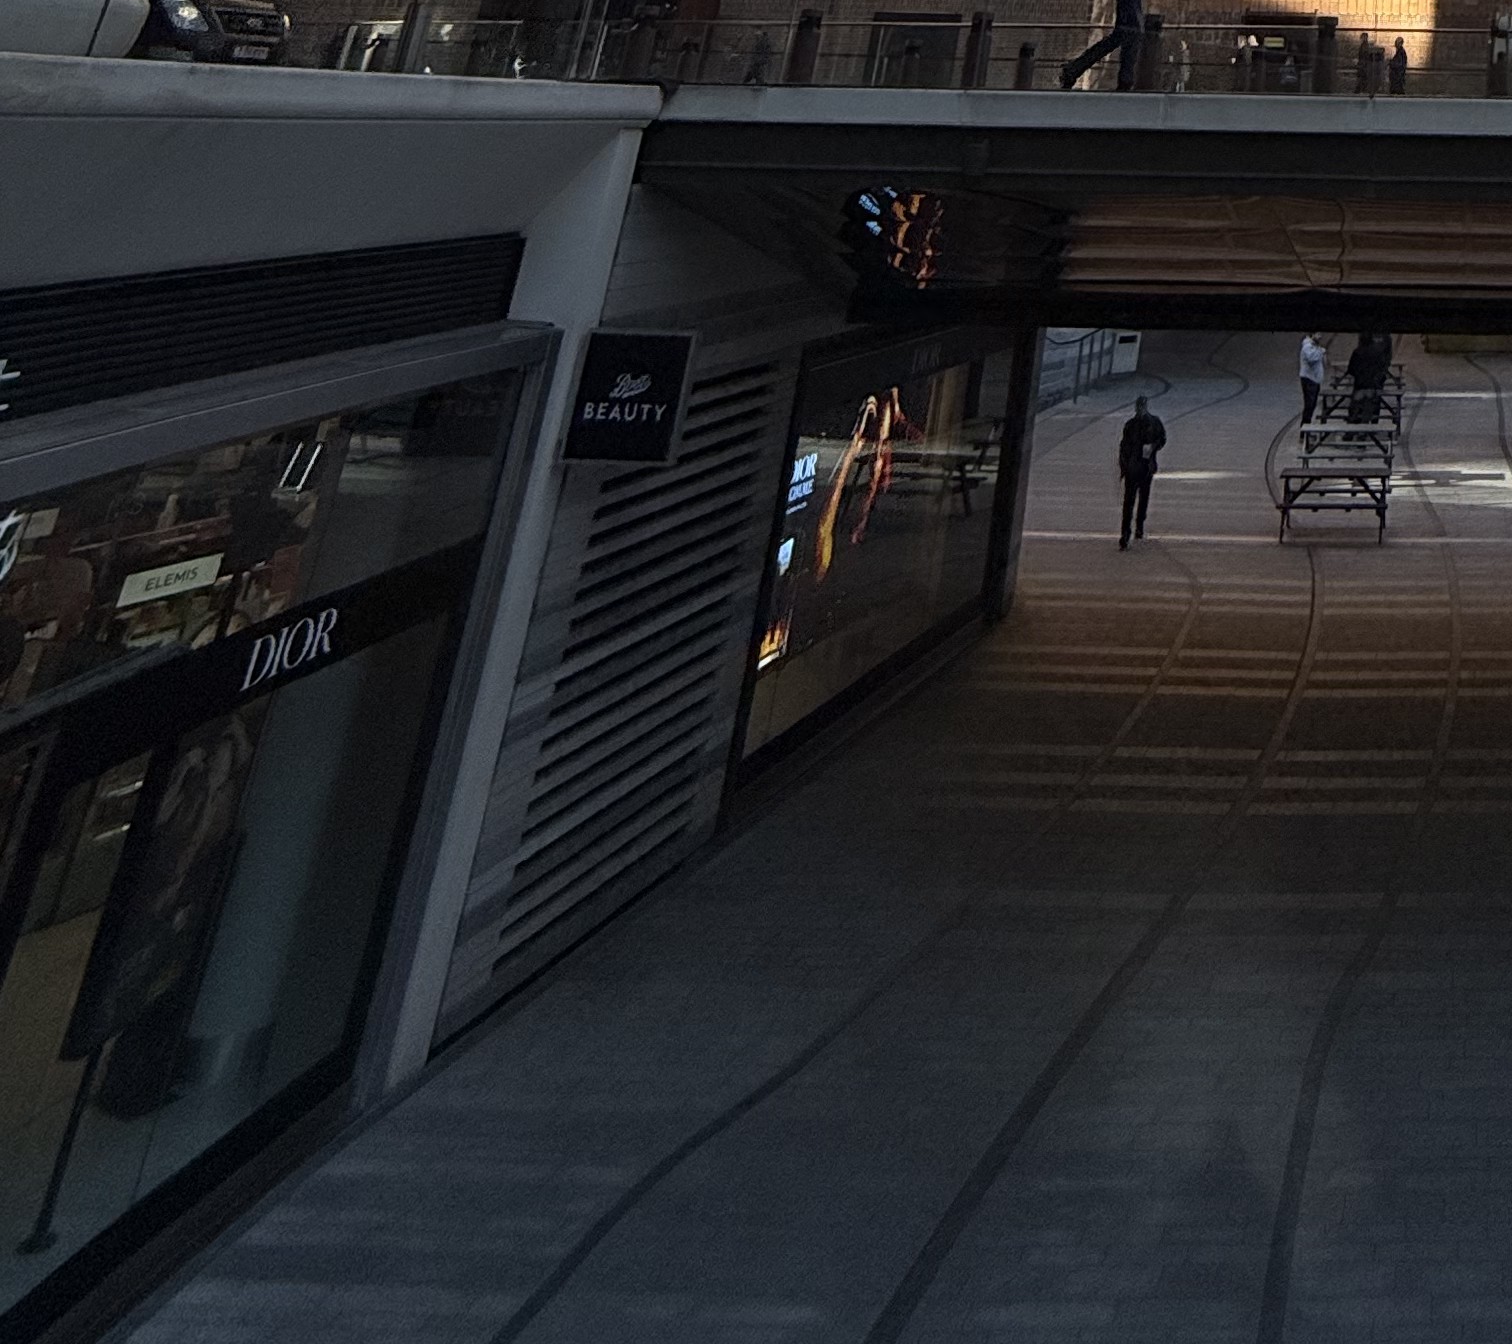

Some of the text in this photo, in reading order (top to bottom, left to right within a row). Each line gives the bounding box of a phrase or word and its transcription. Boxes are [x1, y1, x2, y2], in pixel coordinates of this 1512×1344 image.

[584, 402, 667, 422] BEAUTY
[145, 567, 198, 591] ELEMIS
[240, 608, 338, 691] DIOR
